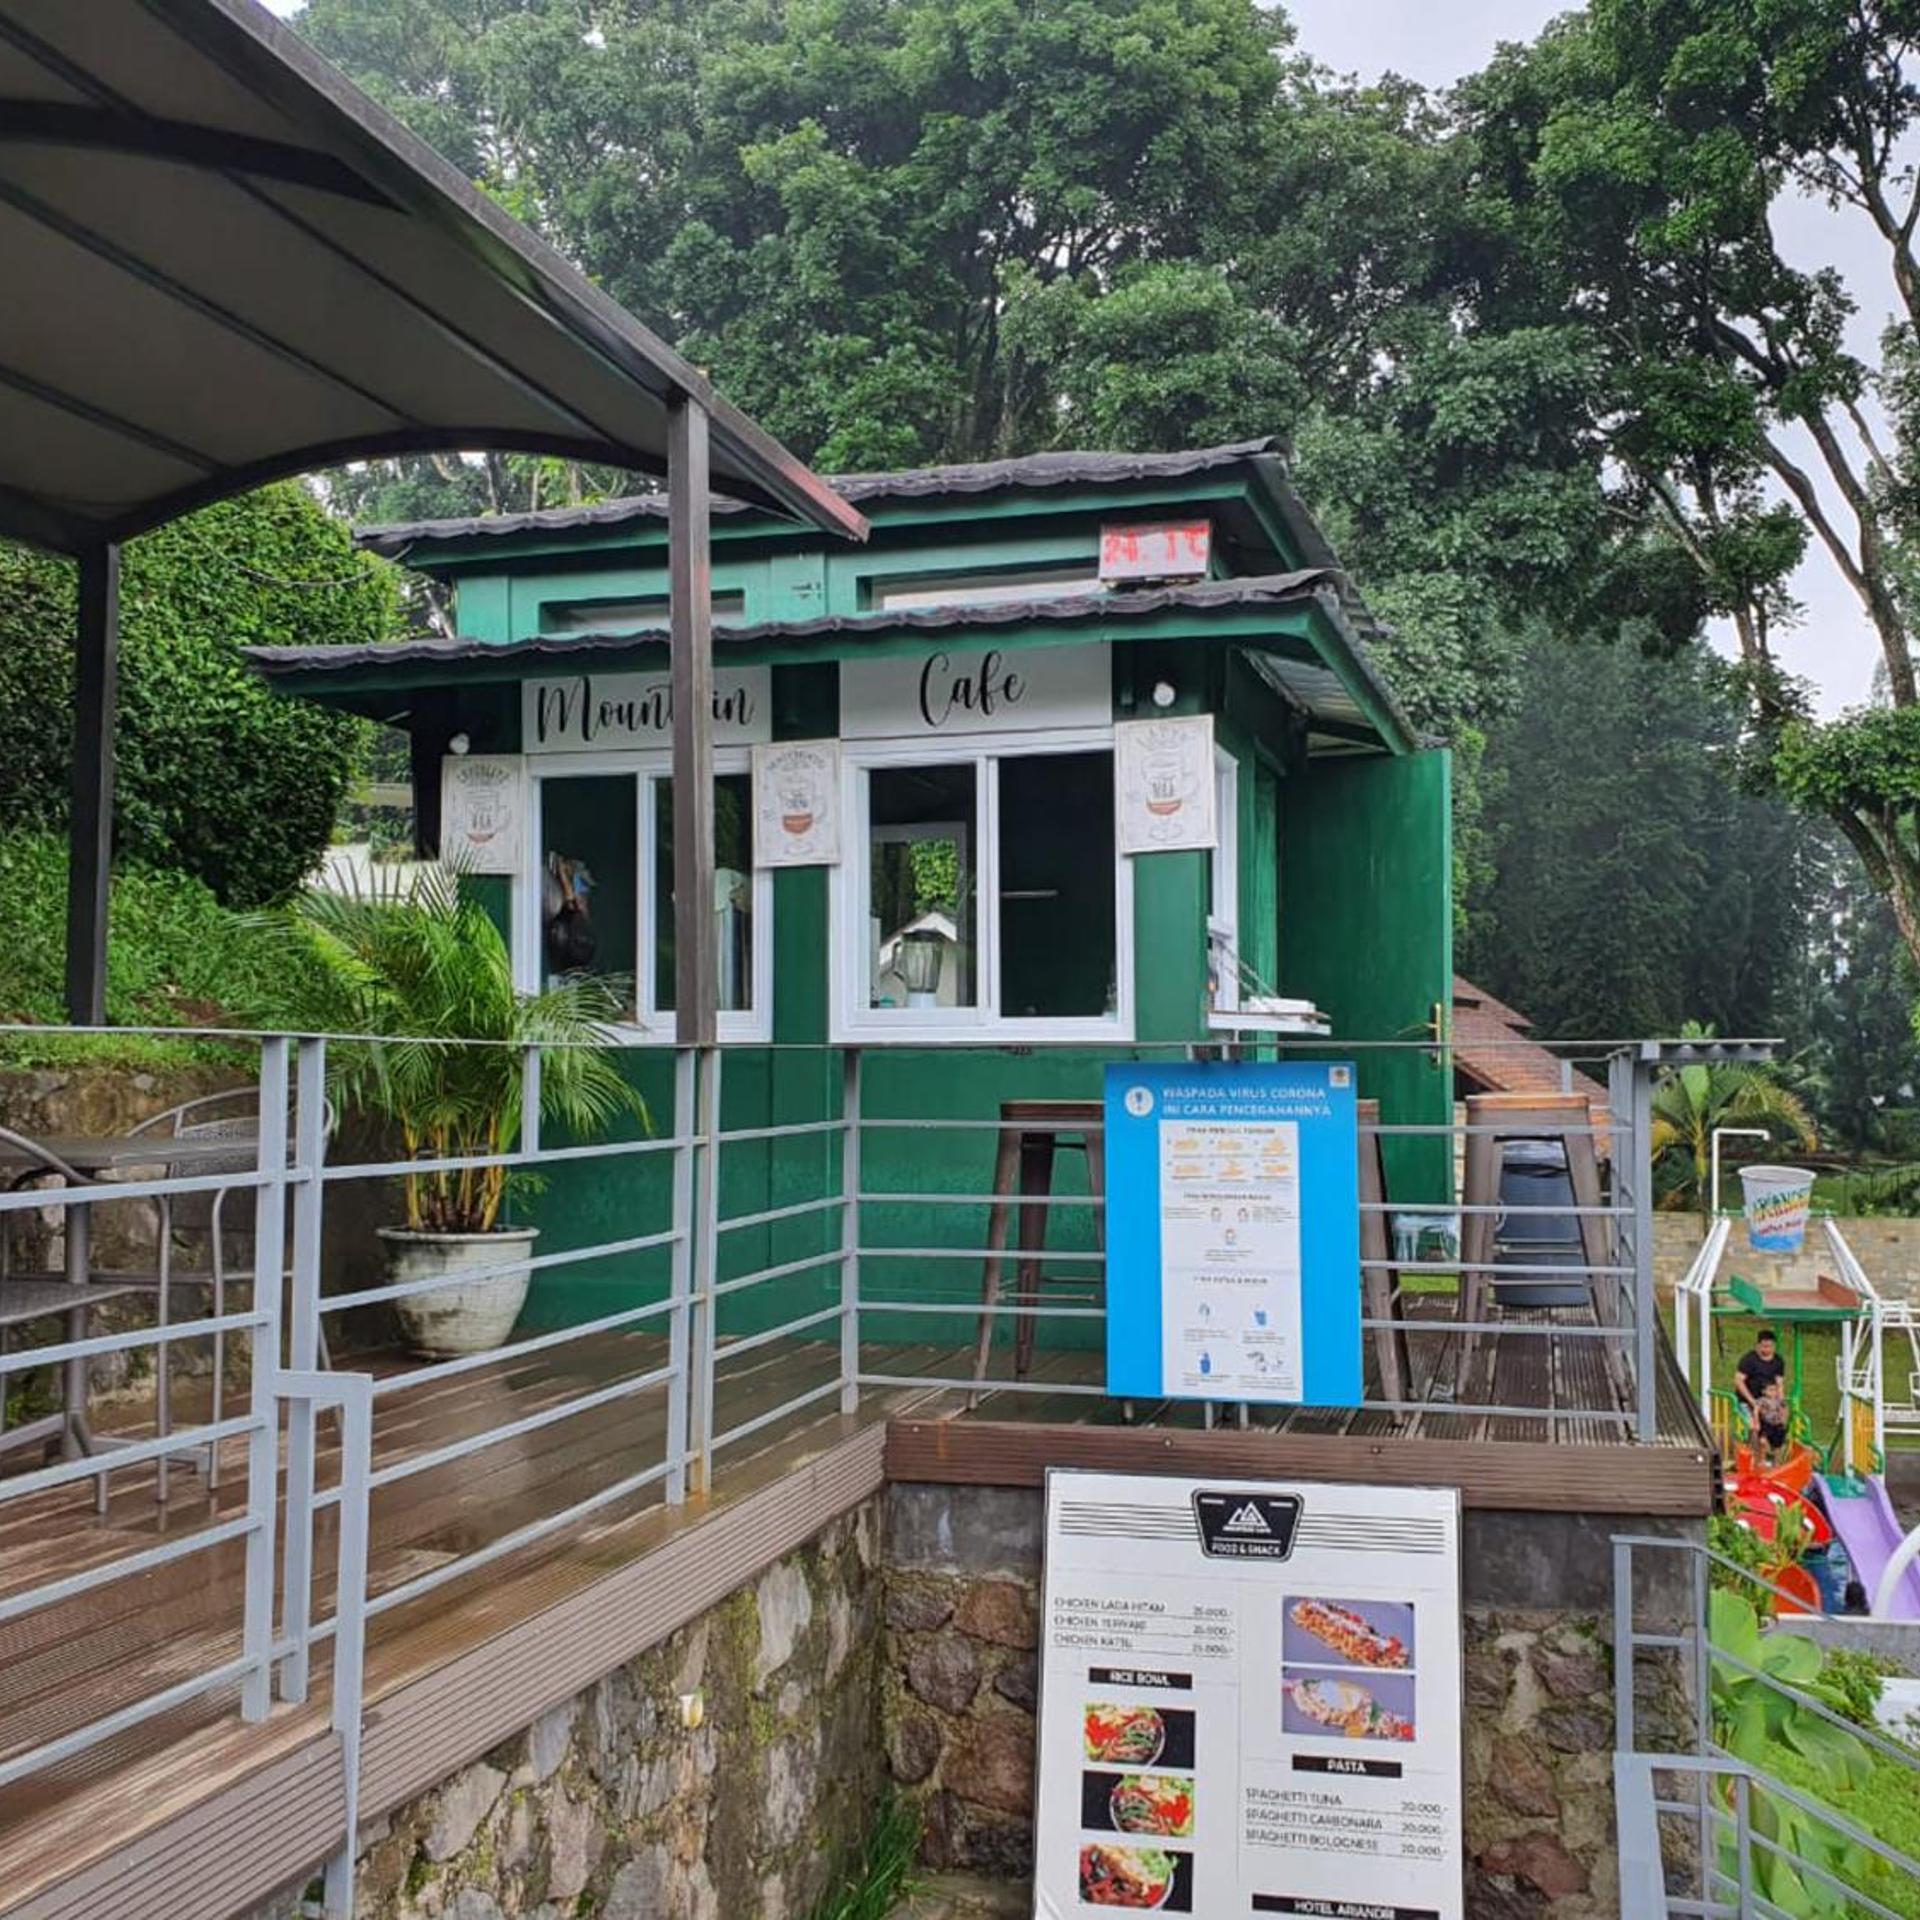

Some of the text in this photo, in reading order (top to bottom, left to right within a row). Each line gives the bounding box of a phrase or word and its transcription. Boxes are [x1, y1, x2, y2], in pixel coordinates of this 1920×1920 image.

[537, 651, 1025, 743] Mountin Cafe
[1163, 1087, 1326, 1100] WASPADA VIRUS CORONA
[1163, 1104, 1332, 1116] INI CARA PENCEGAHANNYA
[1212, 1543, 1237, 1554] FOOD
[1248, 1544, 1280, 1555] SNACK
[1054, 1597, 1098, 1609] CHICKEN
[1101, 1599, 1129, 1610] LADA
[1131, 1601, 1165, 1612] HITAM
[1054, 1615, 1098, 1627] CHICKEN
[1054, 1633, 1098, 1645] CHICKEN
[1109, 1670, 1170, 1686] RICE BOWL
[1327, 1759, 1367, 1773] PASTA
[1246, 1788, 1308, 1802] SPAGHETTI
[1310, 1791, 1343, 1805] TUNA
[1246, 1808, 1308, 1823] SPAGHETTI
[1310, 1813, 1382, 1829] CARBONARA
[1246, 1829, 1308, 1844] SPAGHETTI
[1294, 1901, 1333, 1915] HOTEL
